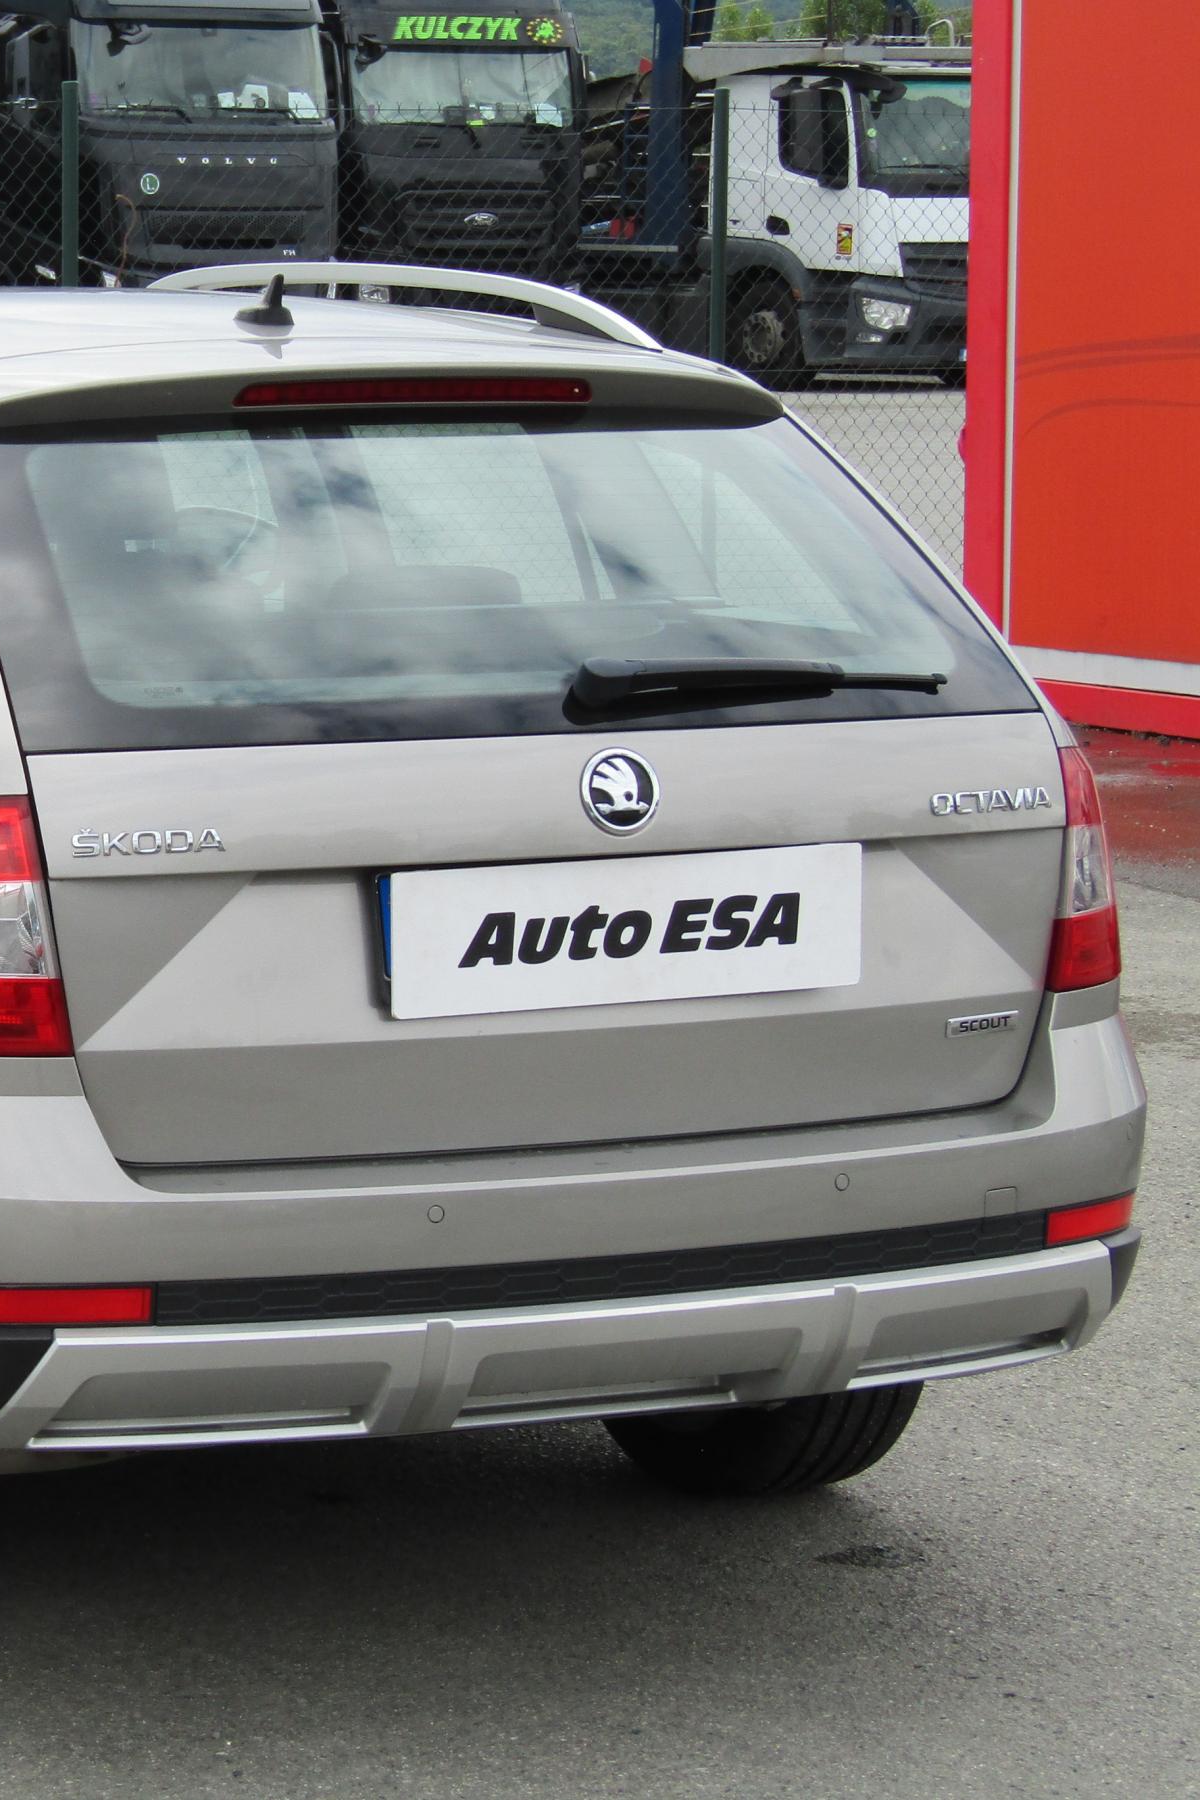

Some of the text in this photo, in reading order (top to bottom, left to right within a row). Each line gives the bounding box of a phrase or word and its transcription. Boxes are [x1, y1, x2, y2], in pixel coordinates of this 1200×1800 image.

[392, 16, 522, 41] KULCZYK
[176, 156, 278, 165] VOLVO
[931, 786, 1052, 816] OCTAVIA
[71, 828, 226, 858] ŠKODA
[458, 892, 801, 969] Auto ESA
[960, 1015, 1011, 1033] SCOUT
